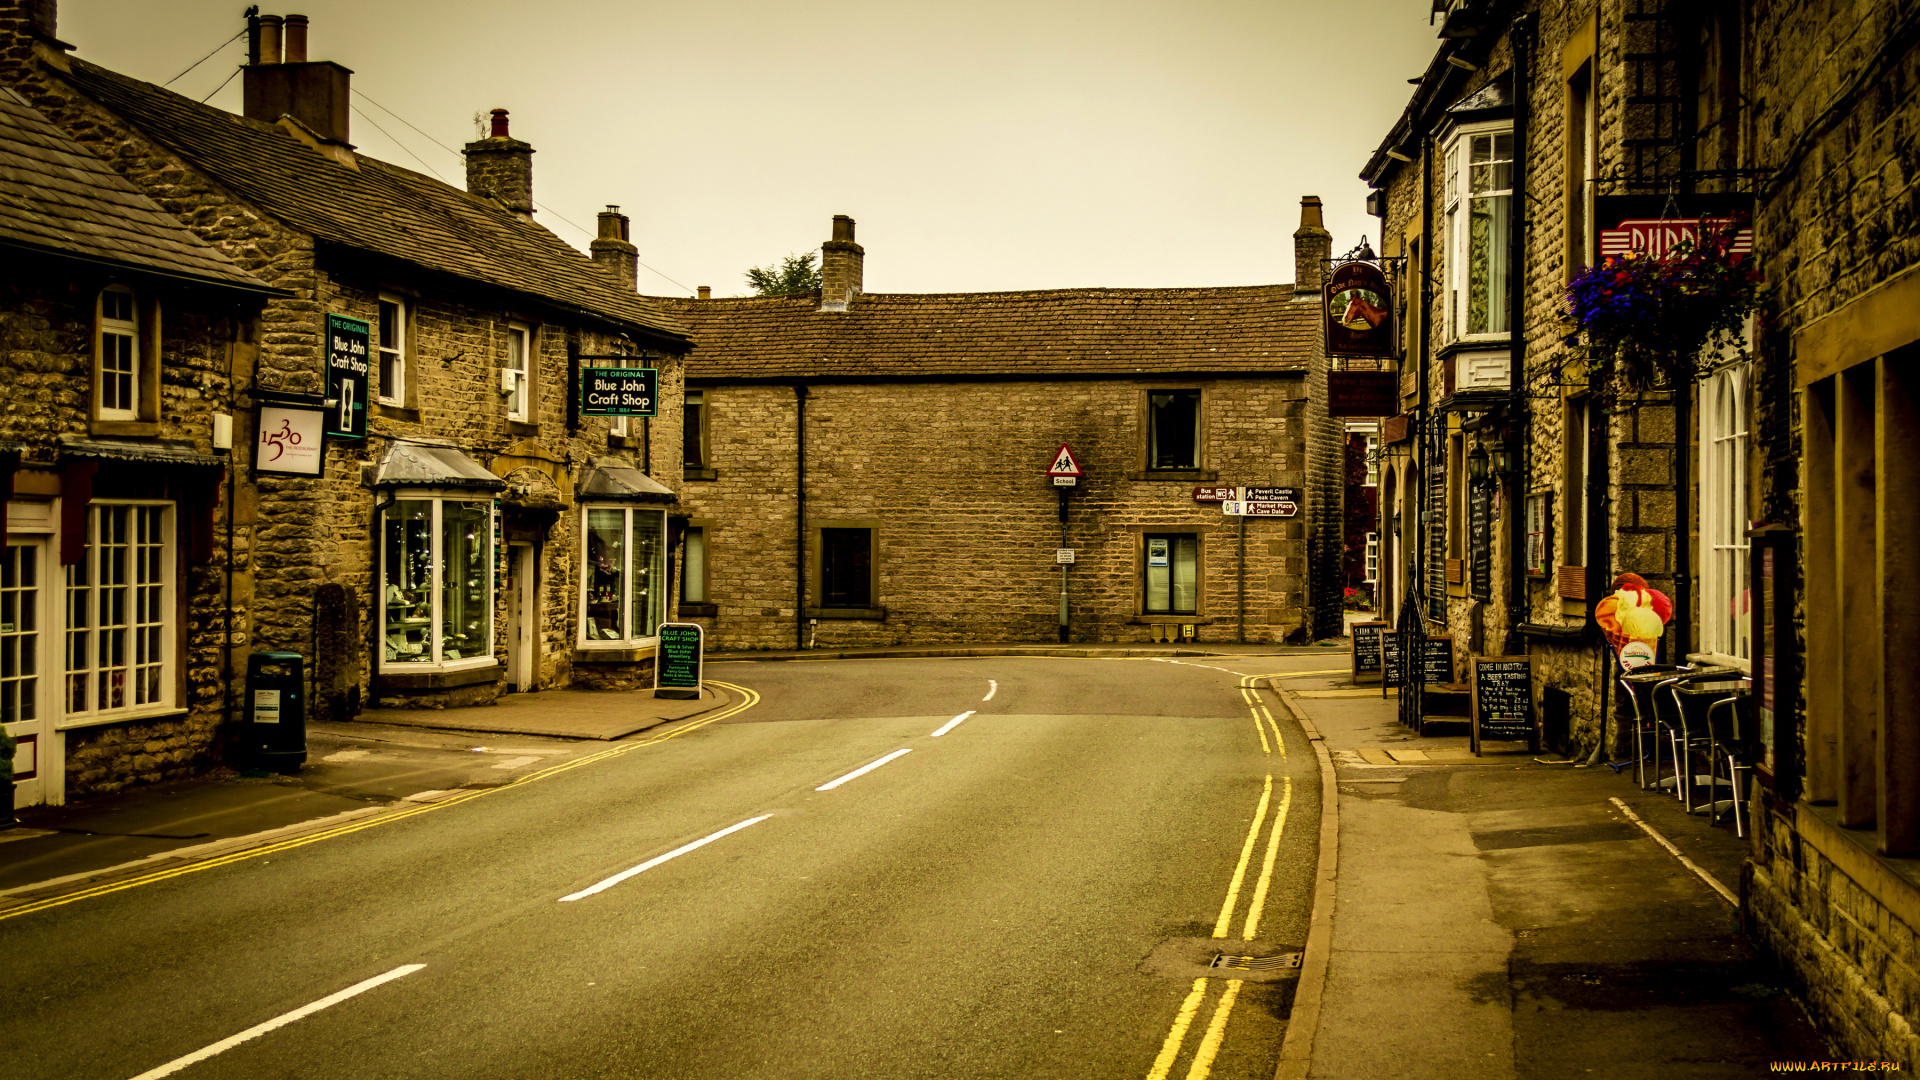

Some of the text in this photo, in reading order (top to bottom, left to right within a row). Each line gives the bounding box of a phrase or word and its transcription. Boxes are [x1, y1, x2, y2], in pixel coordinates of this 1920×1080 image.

[1330, 282, 1346, 294] Olde
[332, 318, 368, 334] THE ORIGINAL
[334, 336, 365, 355] Blue John
[331, 353, 367, 377] Craft Shop
[594, 379, 645, 391] Blue John
[589, 393, 649, 409] Craft Shop
[1184, 626, 1192, 635] H
